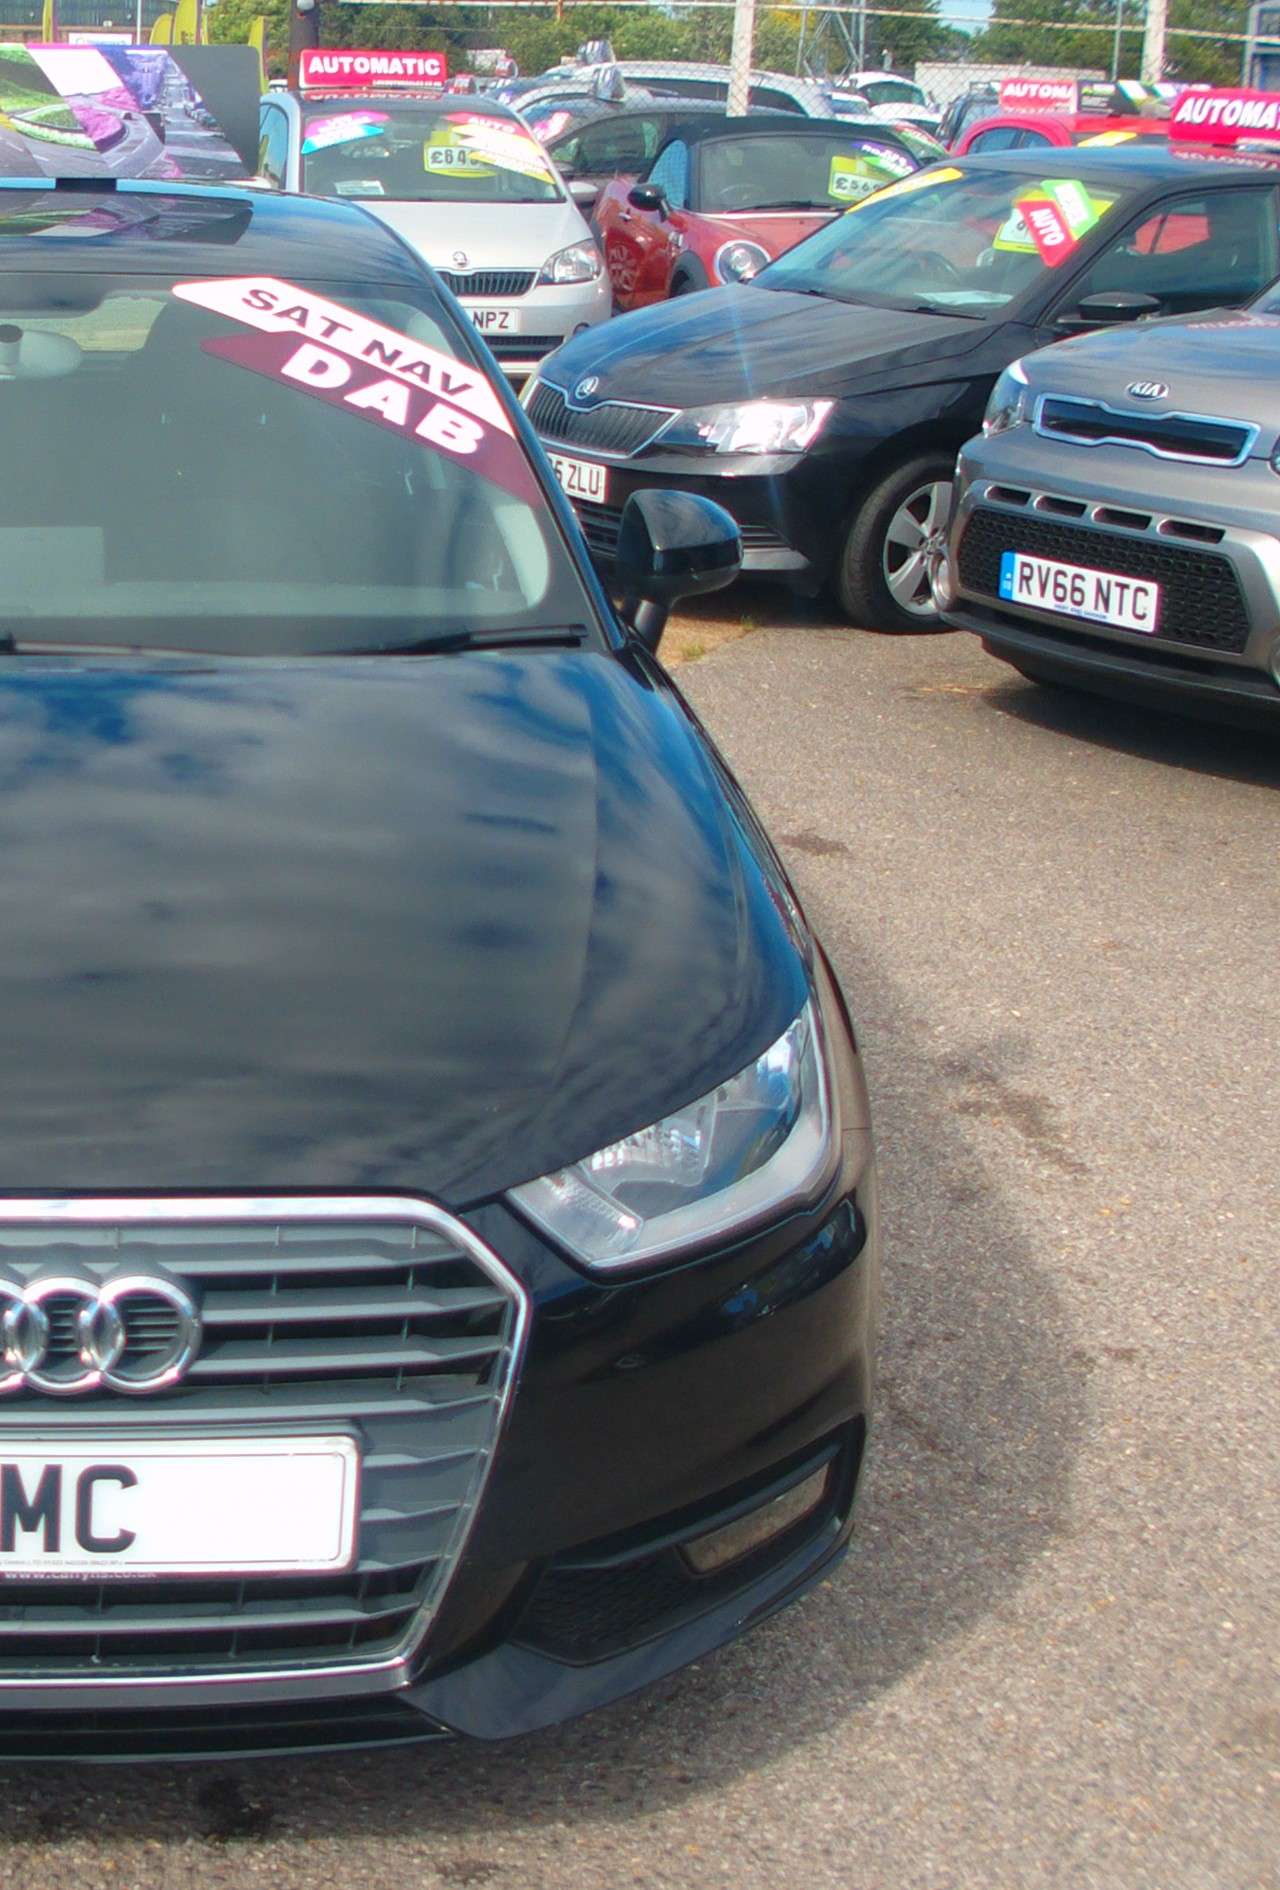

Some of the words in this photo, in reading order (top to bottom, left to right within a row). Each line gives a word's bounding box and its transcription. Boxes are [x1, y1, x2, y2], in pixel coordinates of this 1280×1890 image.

[309, 55, 441, 76] AUTOMATIC
[1174, 97, 1280, 131] AUTOMA
[1029, 208, 1066, 247] AUTO
[472, 311, 510, 329] NPZ
[241, 288, 354, 339] SAT
[361, 339, 473, 398] NAV
[280, 342, 485, 455] DAB
[567, 464, 600, 495] ZLU
[1018, 561, 1086, 607] RV66
[1092, 577, 1149, 621] NTC
